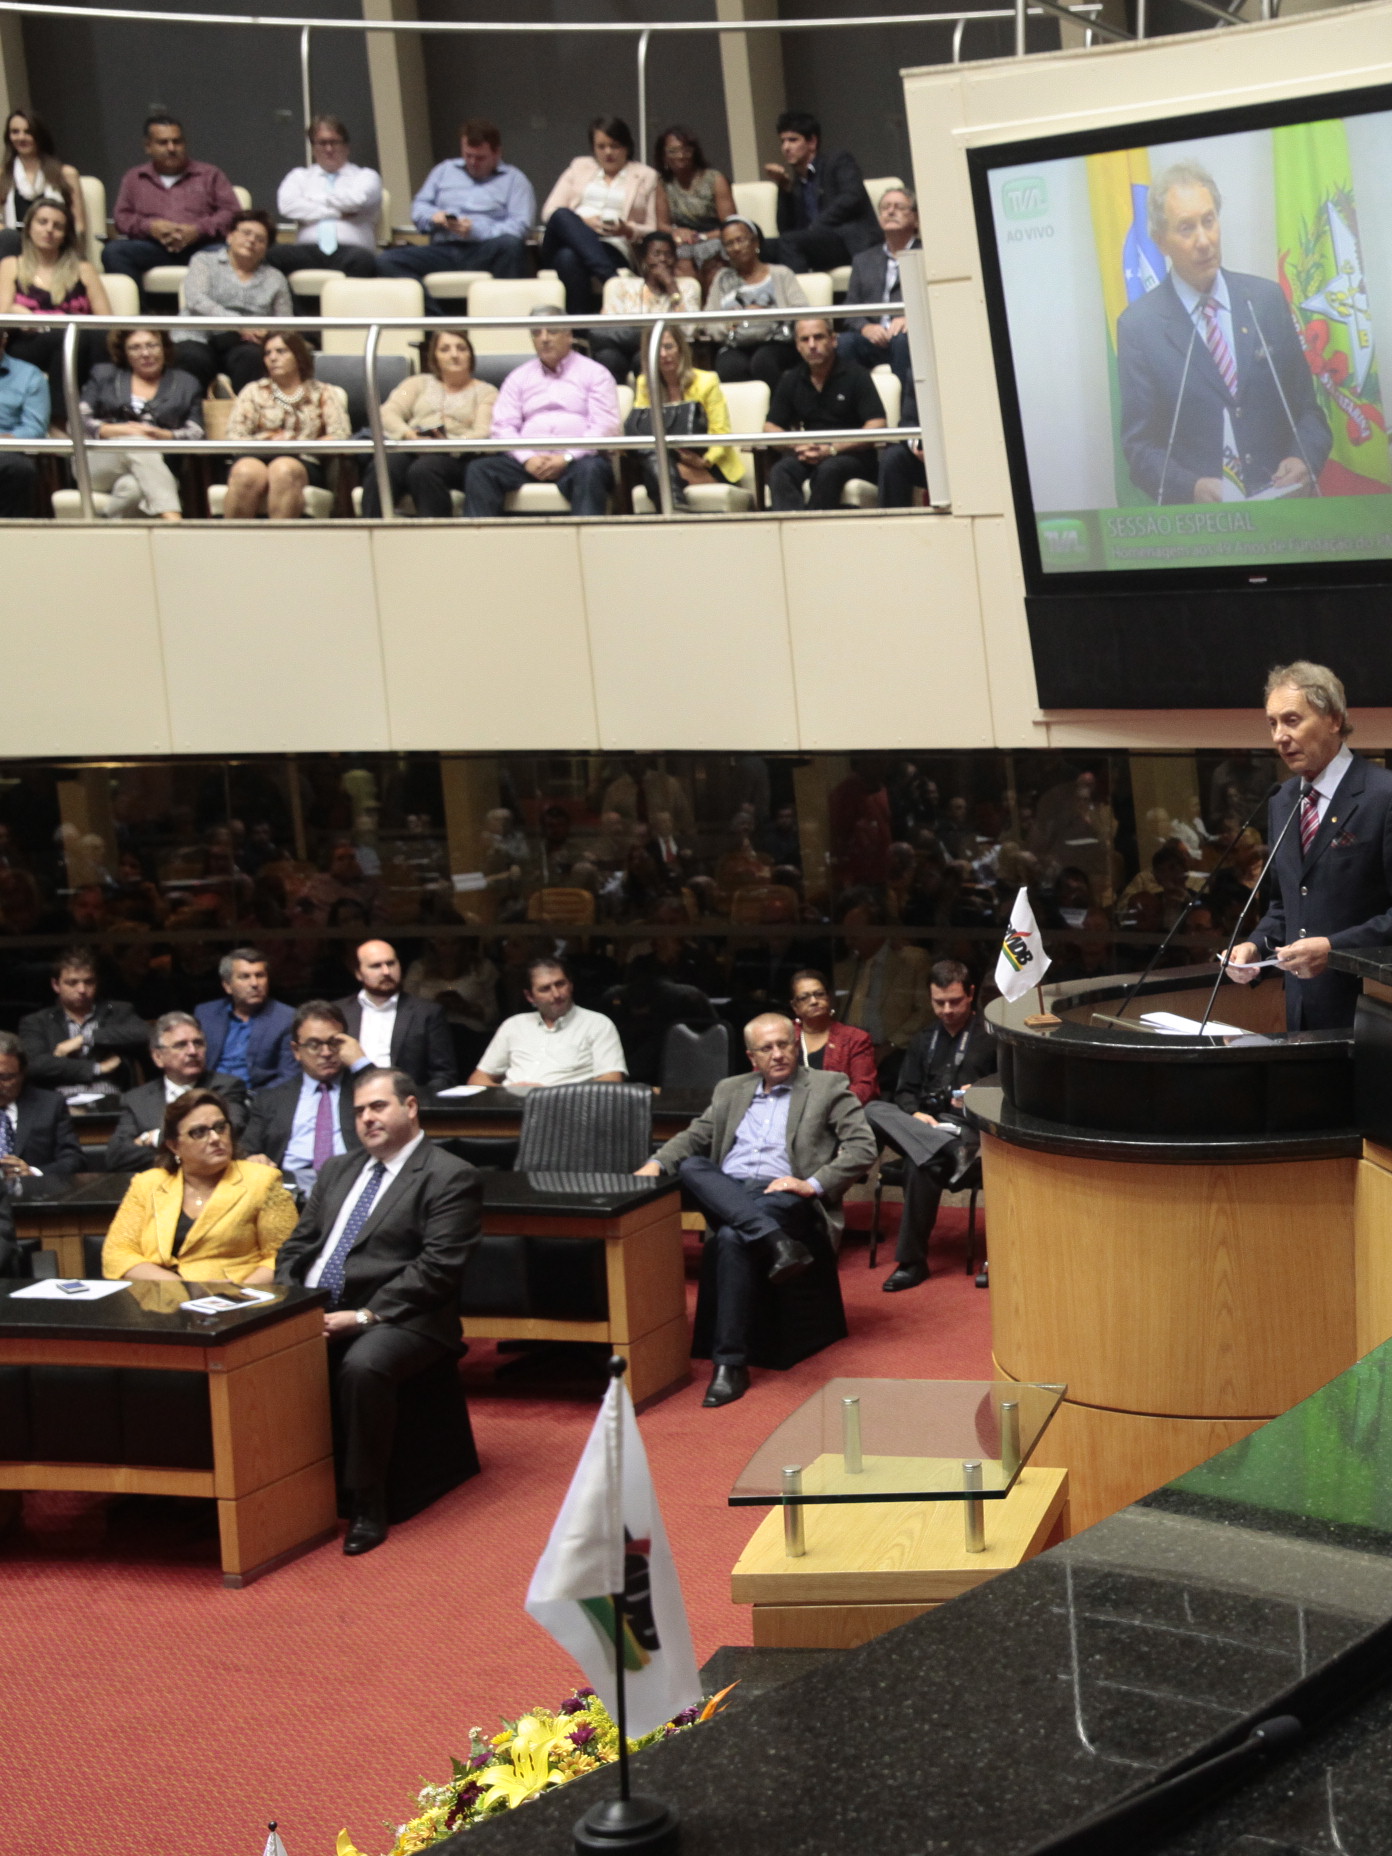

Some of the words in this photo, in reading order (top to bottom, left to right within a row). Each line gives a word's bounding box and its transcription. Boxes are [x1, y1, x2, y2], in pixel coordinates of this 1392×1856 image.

[1007, 229, 1023, 242] AO
[1025, 225, 1055, 240] VIVO
[1107, 512, 1172, 538] SESSÃO
[1176, 510, 1256, 534] ESPECIAL
[1111, 544, 1187, 561] Homenagem
[1234, 540, 1266, 555] Anos
[1269, 539, 1286, 552] de
[1289, 535, 1352, 554] Fundação
[1356, 535, 1373, 549] do
